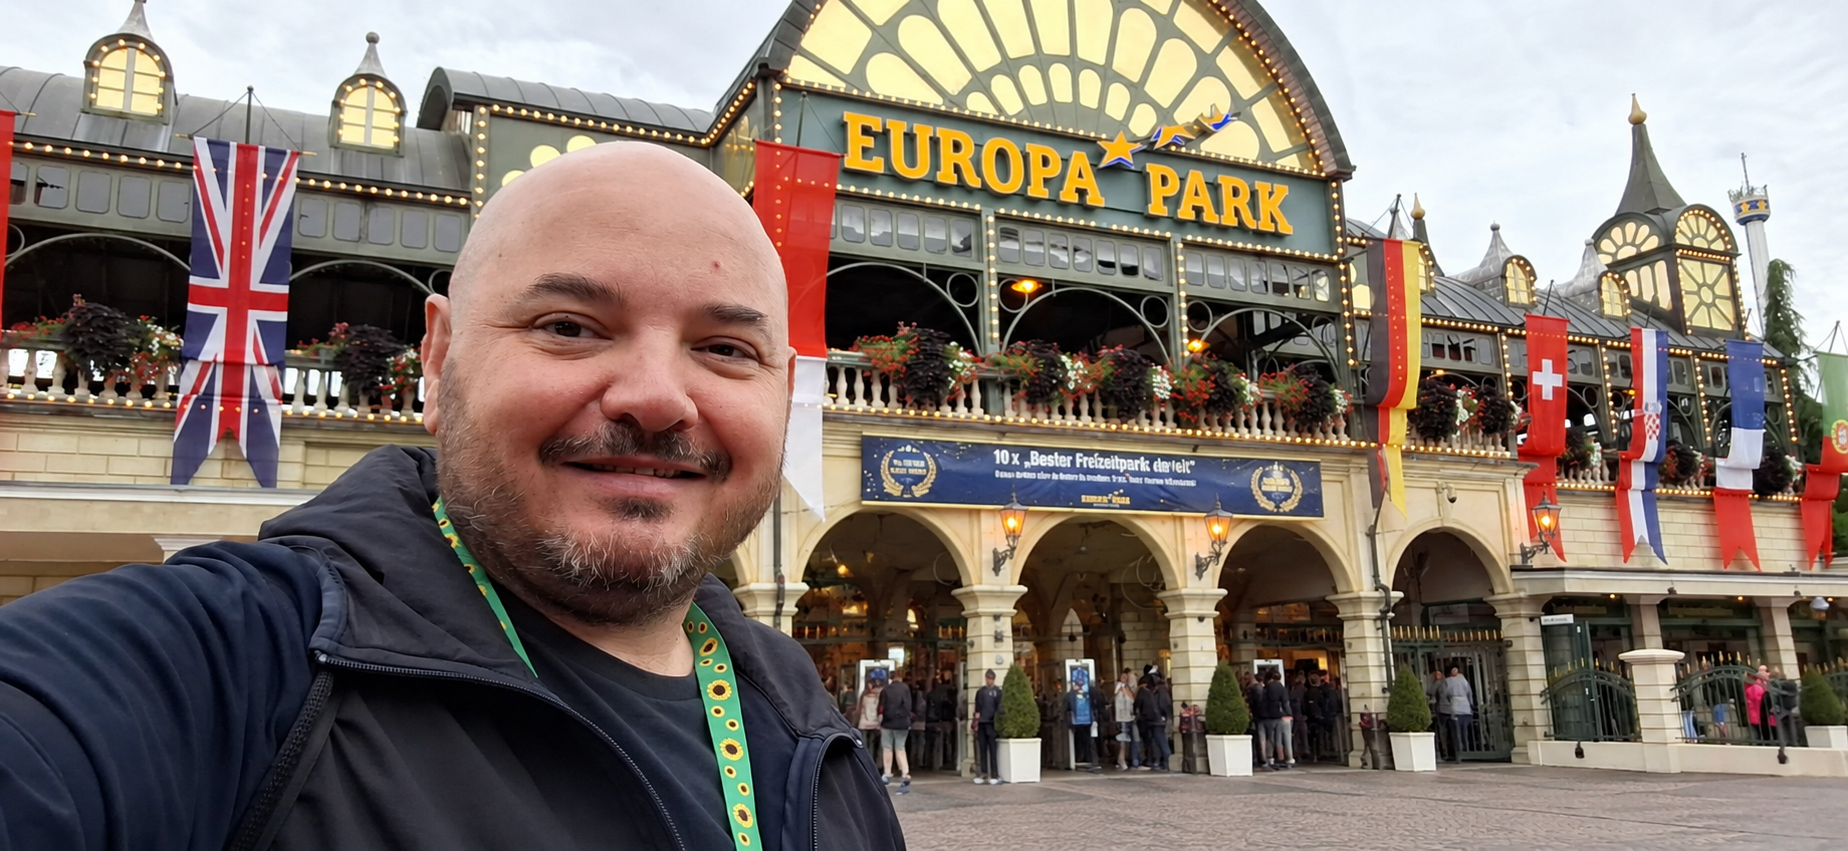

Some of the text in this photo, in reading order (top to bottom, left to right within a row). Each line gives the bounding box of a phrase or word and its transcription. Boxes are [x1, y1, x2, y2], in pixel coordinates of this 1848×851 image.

[843, 111, 1294, 235] EUROPA PARK
[993, 448, 1010, 465] 10
[1011, 453, 1020, 466] x
[1023, 450, 1073, 469] „Bester
[1075, 452, 1151, 474] Freizeitpark
